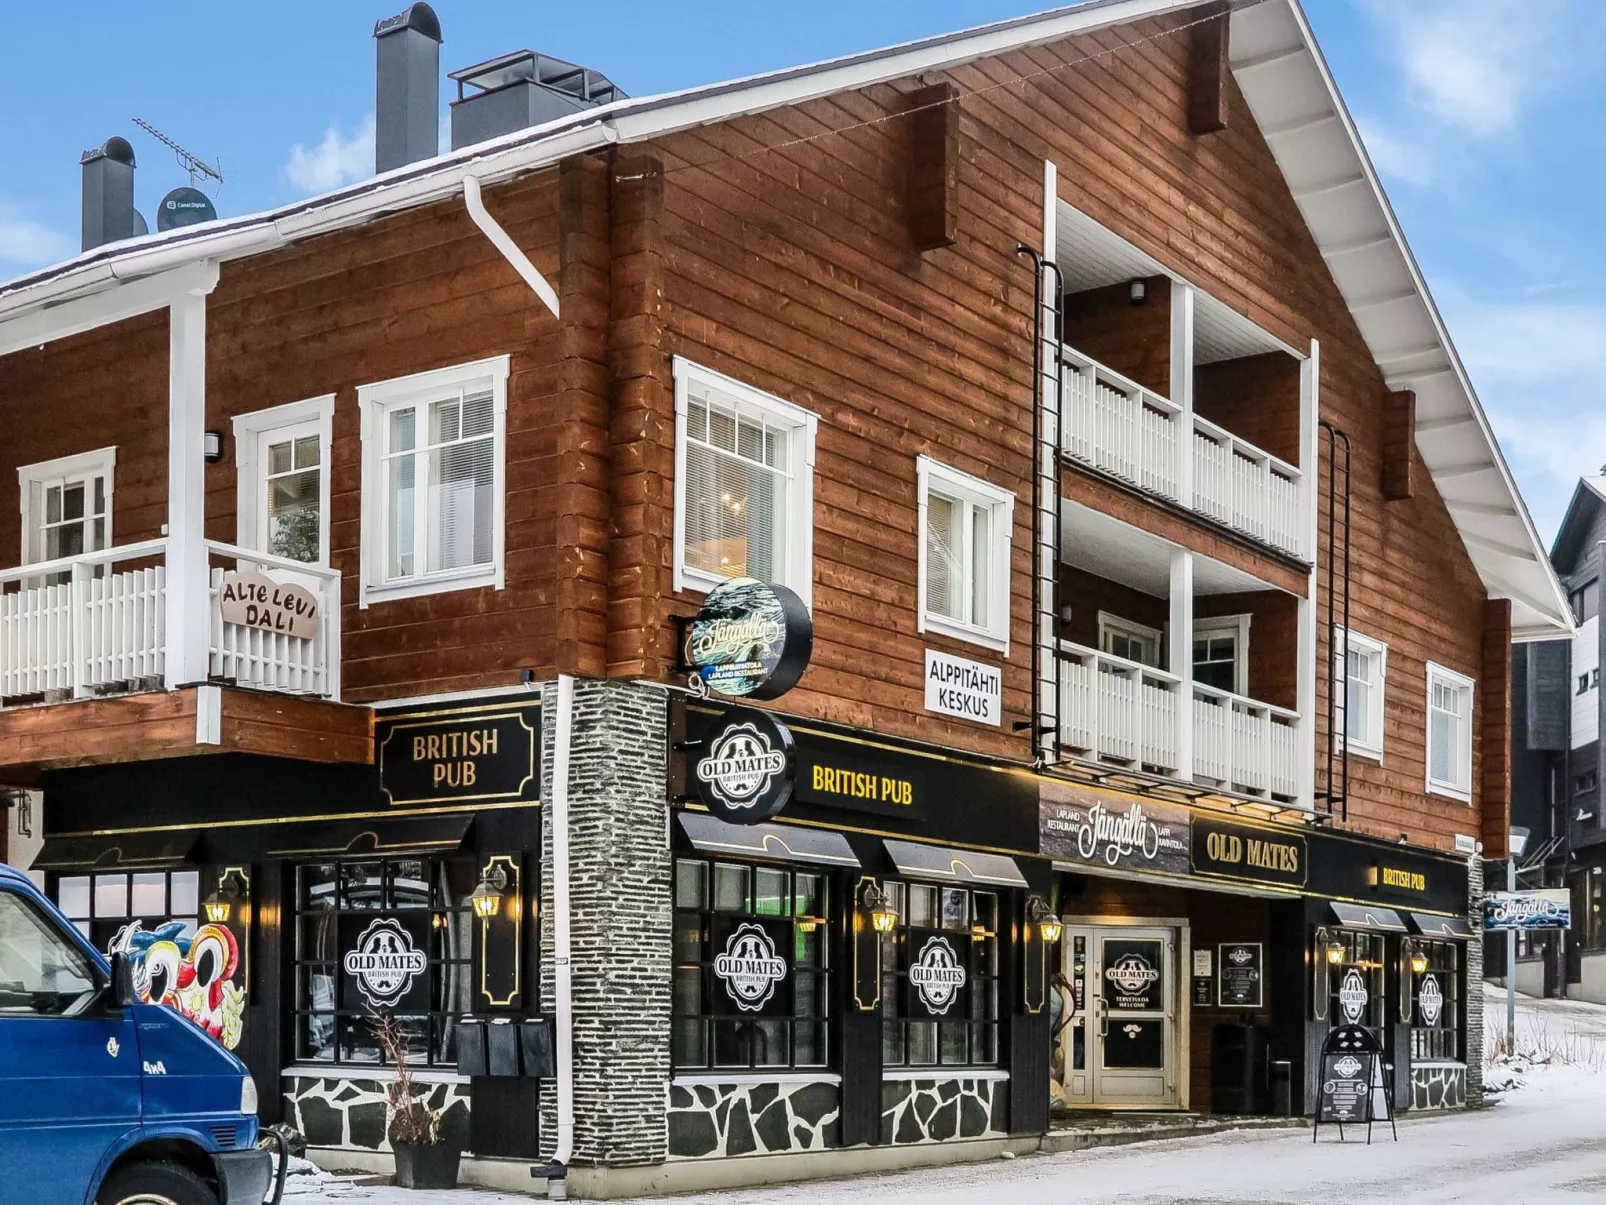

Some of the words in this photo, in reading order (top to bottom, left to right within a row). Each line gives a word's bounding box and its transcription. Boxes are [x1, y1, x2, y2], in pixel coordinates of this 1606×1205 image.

[246, 604, 294, 632] DALI
[929, 659, 999, 697] ALPPITÄHTI
[938, 687, 990, 718] KESKUS
[413, 728, 498, 761] BRITISH
[433, 760, 476, 788] PUB
[702, 761, 732, 777] OLD
[734, 755, 780, 774] MATES
[722, 774, 747, 782] BRITISH
[747, 772, 760, 780] PUB
[812, 764, 877, 799] BRITISH
[881, 777, 913, 805] PUB
[1056, 808, 1081, 822] LAPLAND
[1047, 819, 1080, 833] RESTAURANT
[1206, 832, 1242, 863] OLD
[1246, 838, 1298, 873] MATES
[1383, 867, 1411, 889] BRITISH
[1411, 873, 1426, 891] PUB
[348, 955, 375, 970] OLD
[378, 955, 422, 970] MATES
[718, 958, 743, 973] OLD
[745, 960, 783, 976] MATES
[367, 970, 389, 978] BRITISH
[390, 970, 402, 978] PUB
[912, 967, 932, 981] OLD
[934, 969, 963, 983] MATES
[1108, 970, 1127, 978] OLD
[1128, 971, 1157, 979] MATES
[1340, 991, 1351, 1001] OLD
[1351, 992, 1367, 1002] MATES
[143, 1060, 167, 1075] 4x4
